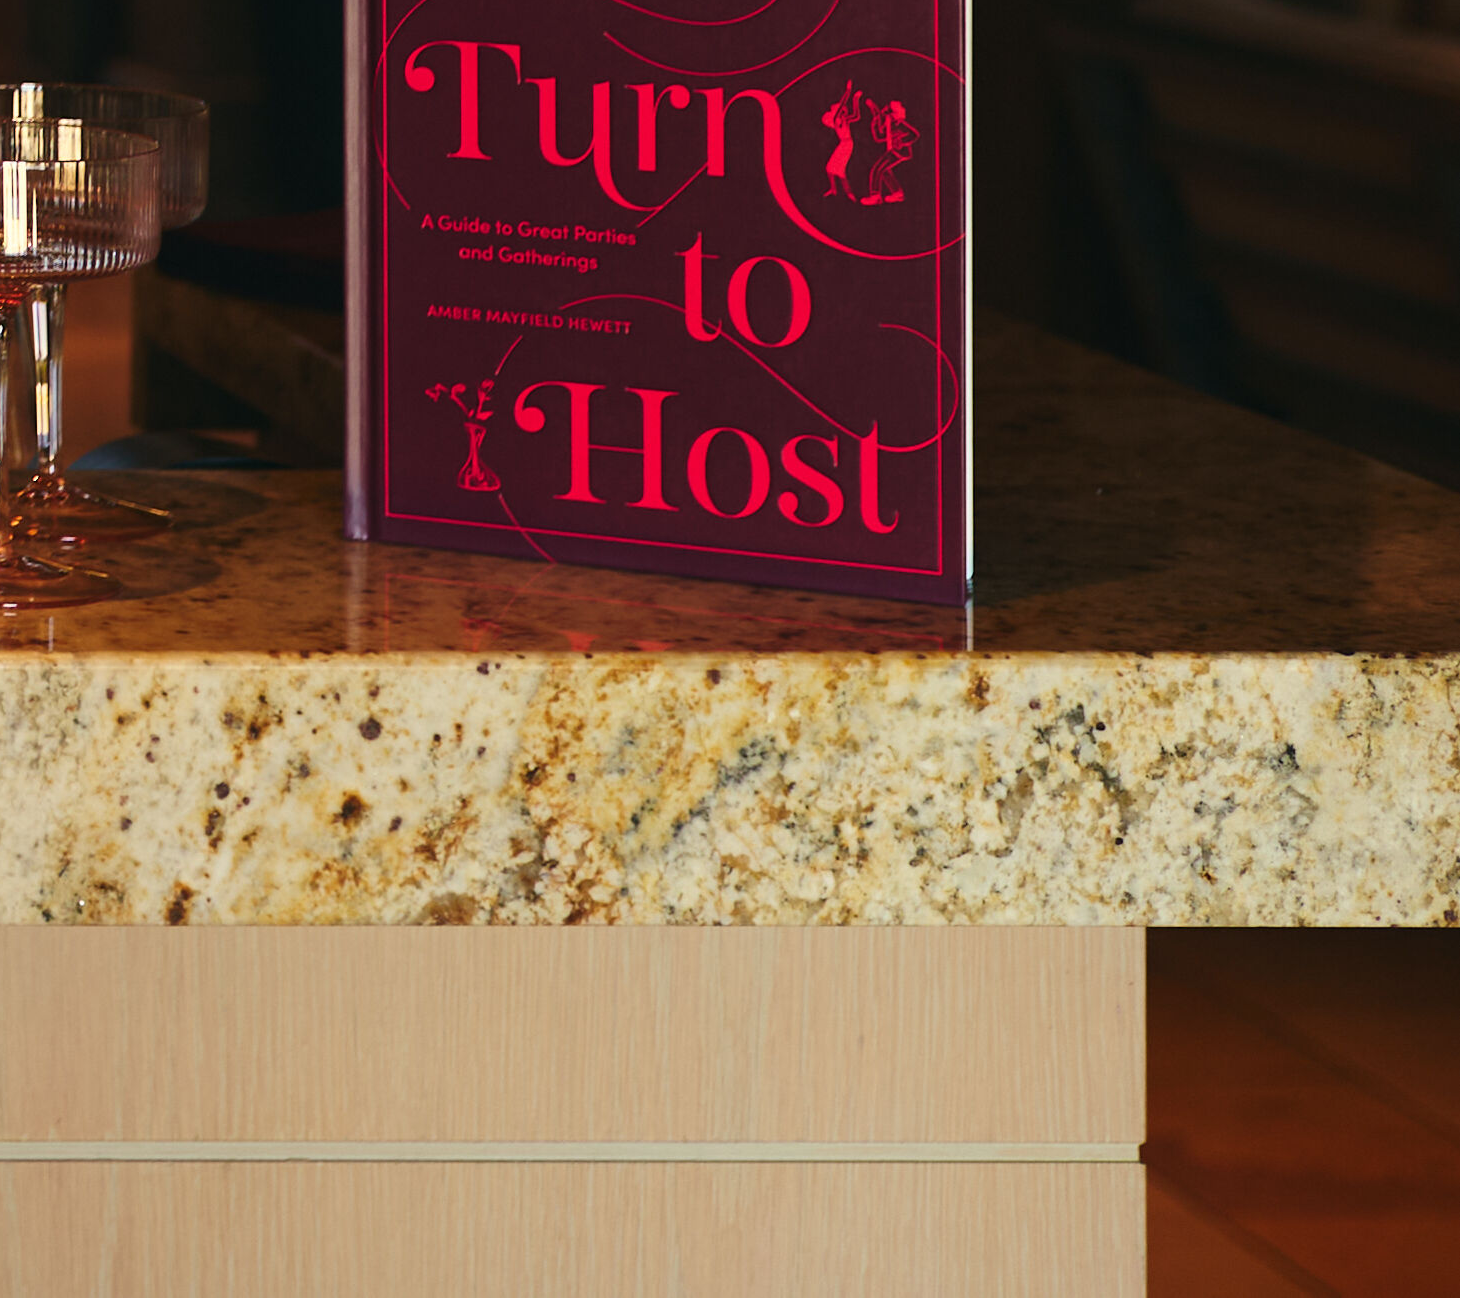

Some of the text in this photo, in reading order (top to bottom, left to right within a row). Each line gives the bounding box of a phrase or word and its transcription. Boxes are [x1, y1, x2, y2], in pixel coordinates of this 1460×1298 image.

[404, 39, 799, 204] Turn
[421, 214, 637, 246] A Guide to Great Parties
[458, 245, 598, 274] and Gatherings
[427, 304, 632, 334] AMBER MAYFIELD HEWETT
[675, 231, 811, 349] to
[514, 379, 900, 534] Host
